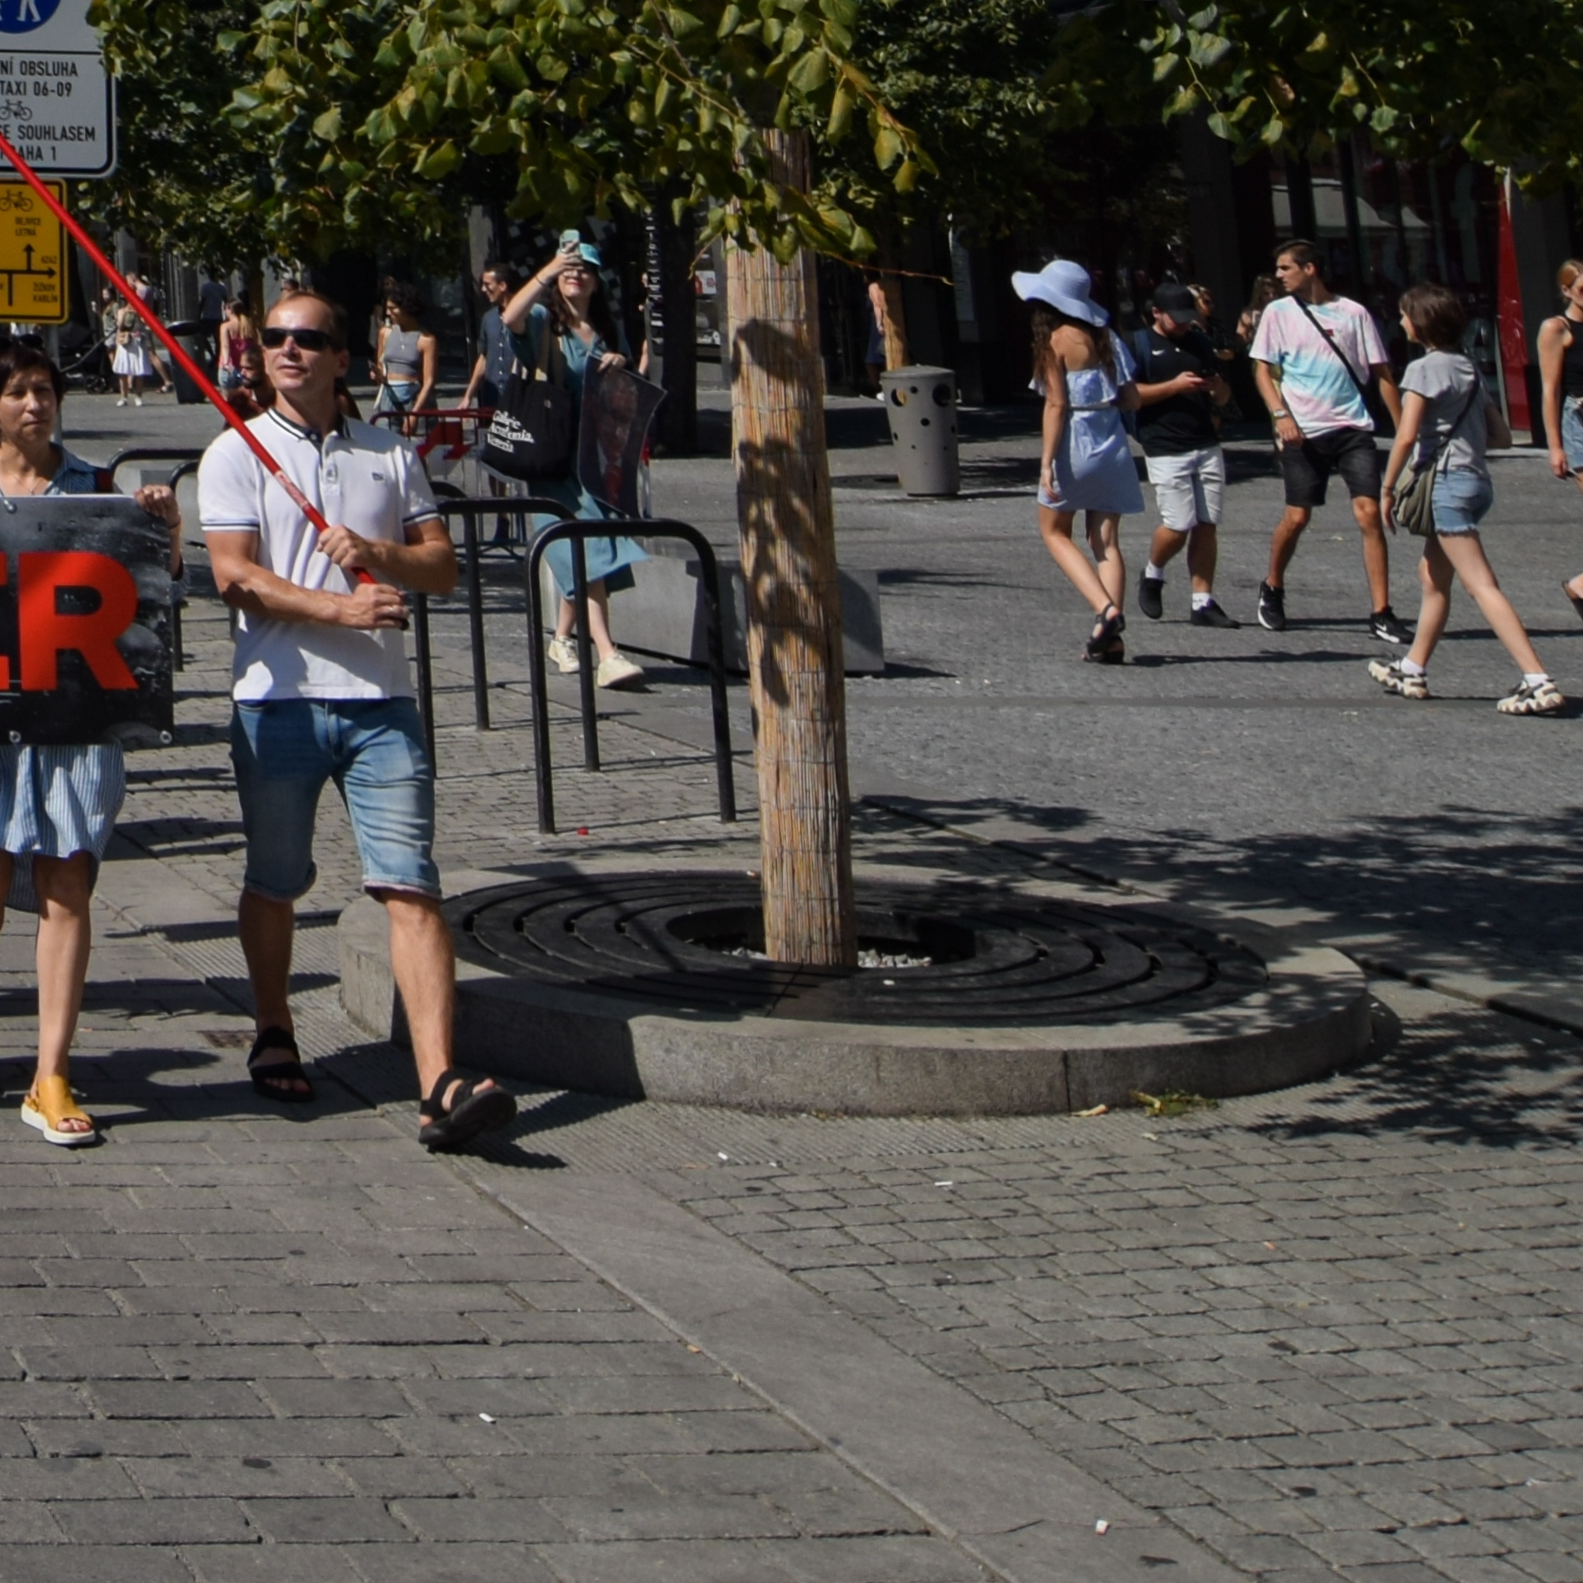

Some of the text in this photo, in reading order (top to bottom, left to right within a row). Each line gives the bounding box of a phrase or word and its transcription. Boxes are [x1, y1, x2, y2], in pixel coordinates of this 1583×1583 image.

[19, 60, 78, 77] OBSLUHA
[0, 80, 27, 96] TAXI
[33, 81, 73, 97] 06-09
[17, 125, 96, 142] SOUHLASEM
[51, 146, 57, 161] 1
